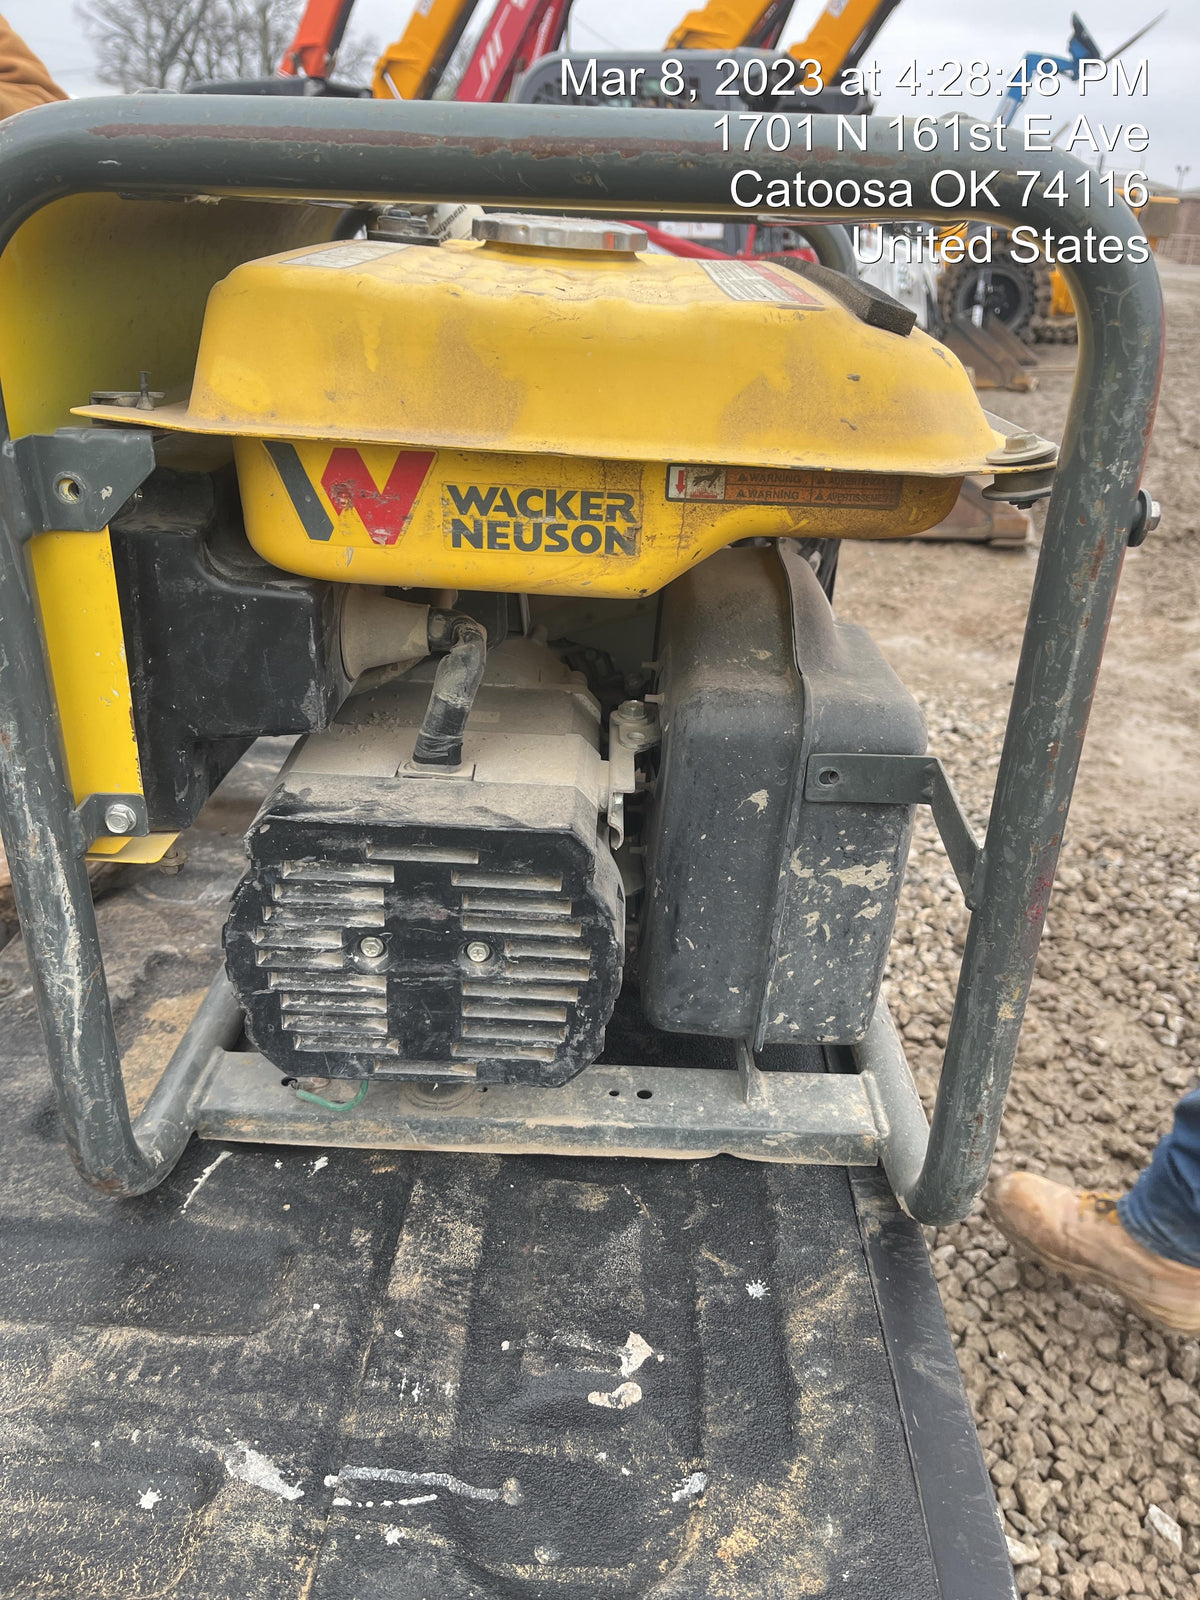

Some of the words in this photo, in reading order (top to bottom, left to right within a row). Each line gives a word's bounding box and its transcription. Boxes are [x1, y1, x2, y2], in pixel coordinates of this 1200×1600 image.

[750, 471, 801, 484] WARNING
[446, 484, 637, 524] WACKER
[748, 488, 799, 500] WARNING
[451, 518, 635, 556] NEUSON
